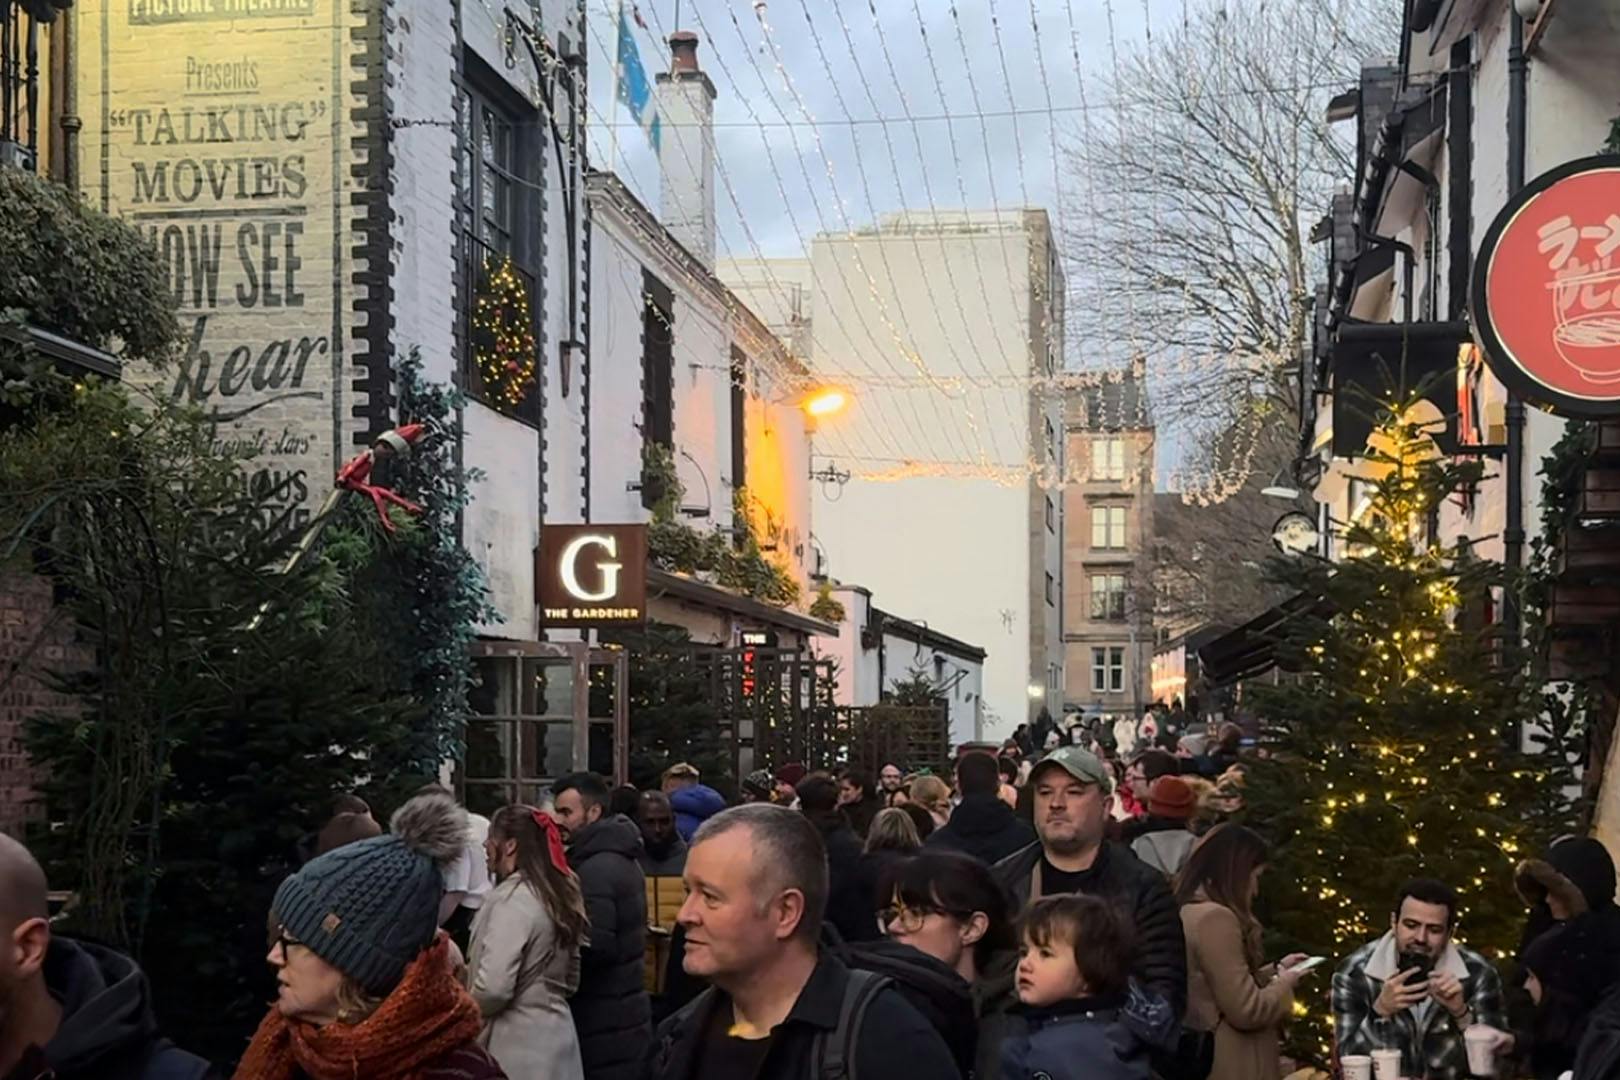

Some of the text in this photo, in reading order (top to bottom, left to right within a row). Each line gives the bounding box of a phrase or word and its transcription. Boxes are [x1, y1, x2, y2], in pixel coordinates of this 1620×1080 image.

[186, 56, 259, 90] Presents
[131, 155, 309, 203] MOVIES
[236, 222, 304, 308] SEE
[171, 315, 328, 402] hear
[560, 535, 623, 601] G
[545, 608, 639, 619] THE GARDENER
